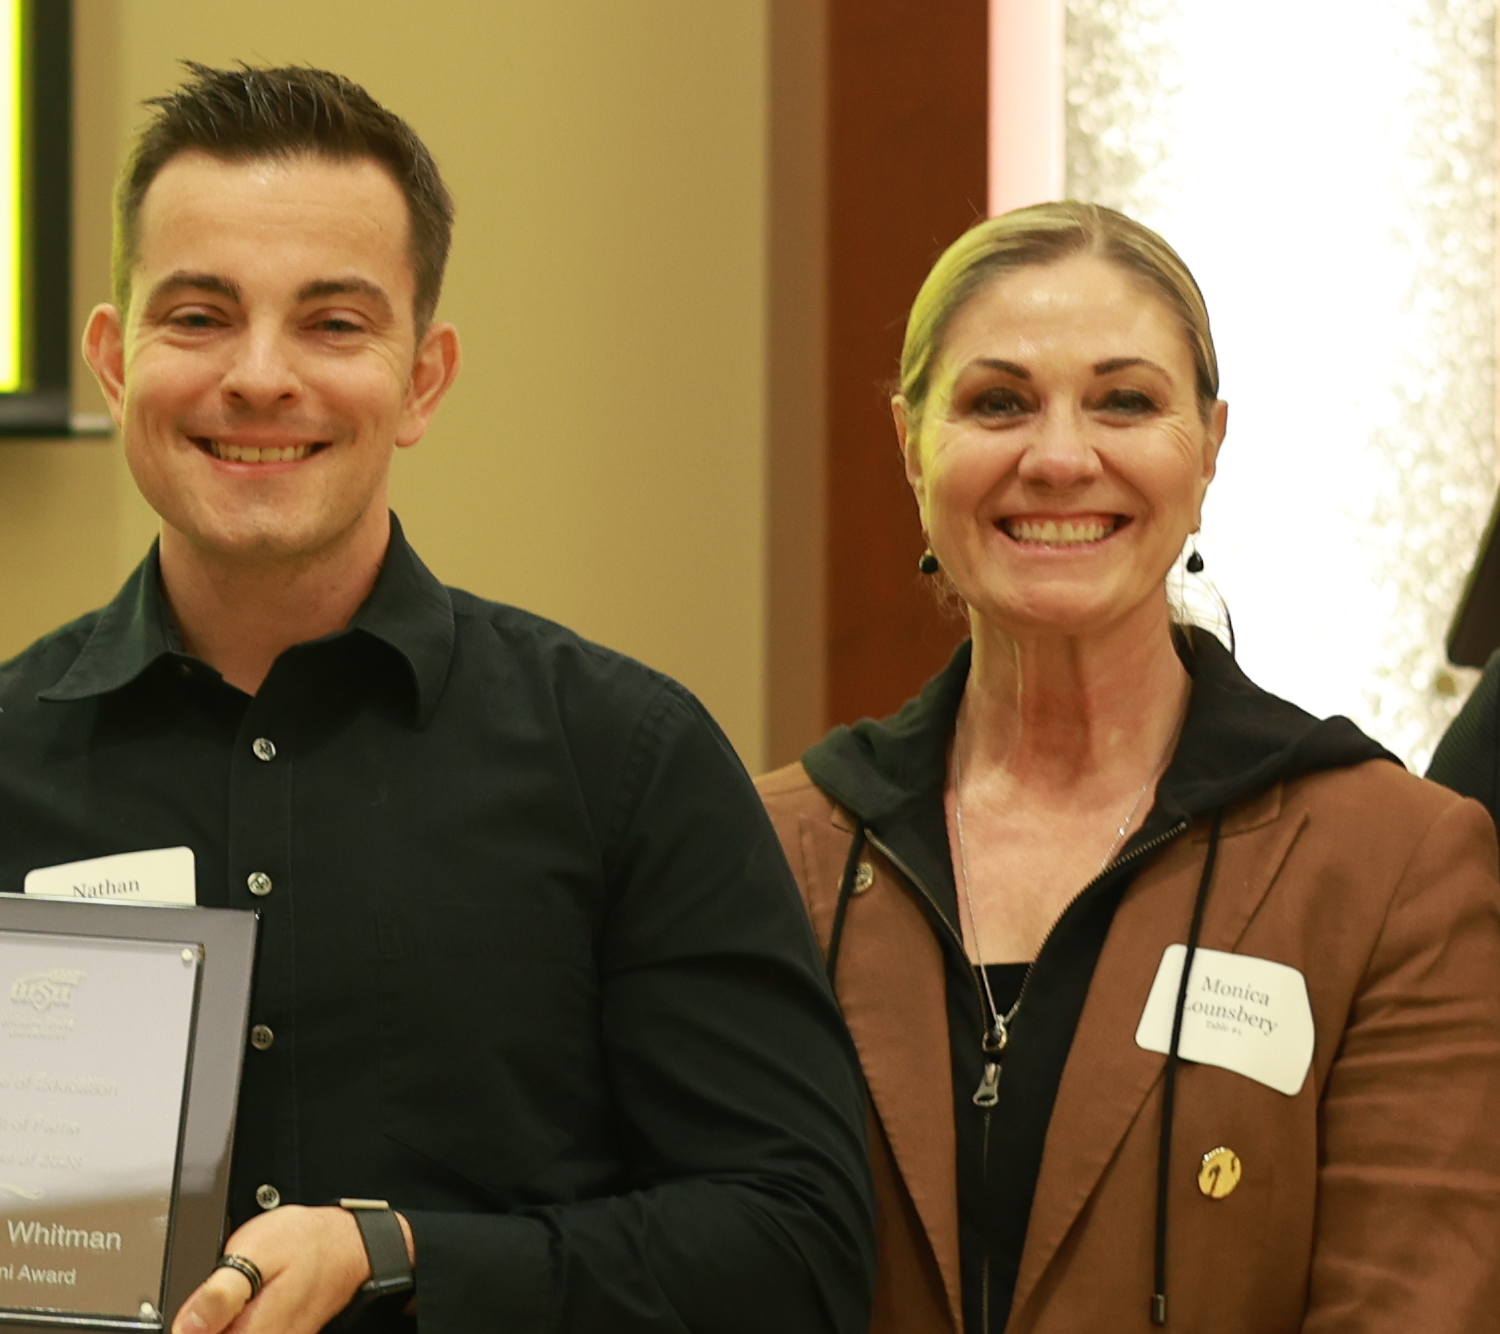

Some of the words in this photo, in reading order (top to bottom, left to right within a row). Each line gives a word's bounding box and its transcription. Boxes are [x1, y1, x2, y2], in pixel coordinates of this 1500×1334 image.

[72, 879, 140, 899] Nathan
[1201, 975, 1271, 1007] Monica
[1184, 1000, 1279, 1037] ounsbery
[7, 1219, 122, 1252] Whitman
[16, 1264, 77, 1287] Award
